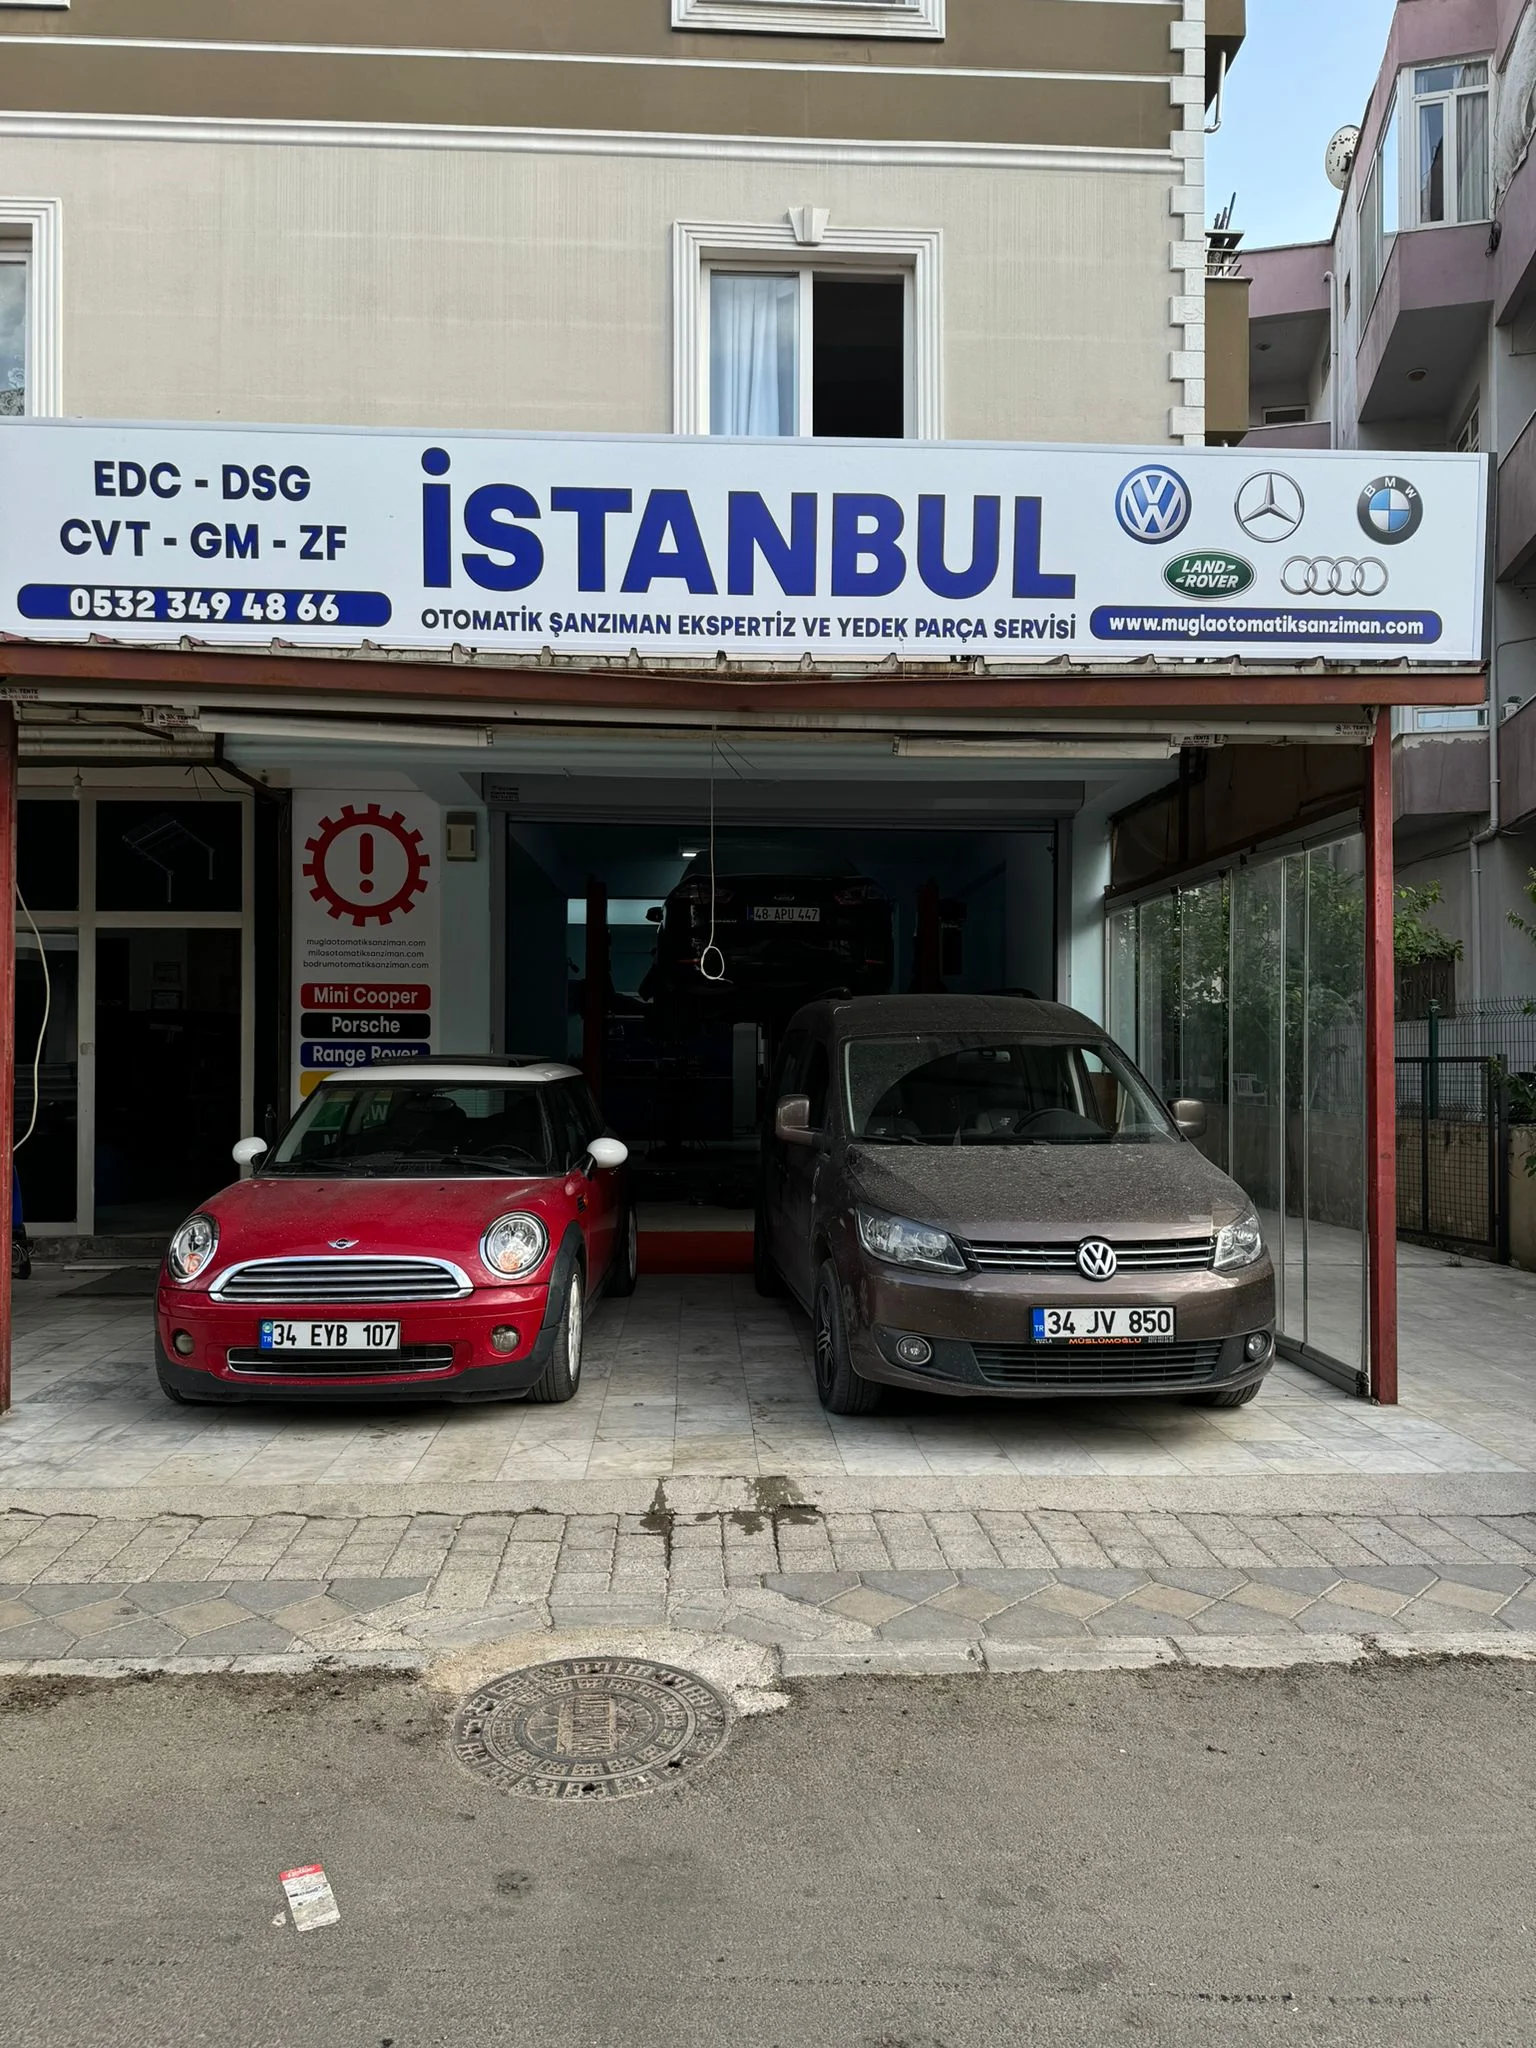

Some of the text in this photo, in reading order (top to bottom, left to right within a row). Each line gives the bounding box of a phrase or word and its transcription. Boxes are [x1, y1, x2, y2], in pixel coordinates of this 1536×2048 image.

[94, 459, 182, 499] EDC
[221, 463, 311, 502] DSG
[1362, 476, 1418, 500] BMW
[420, 446, 1077, 600] İSTANBUL
[59, 518, 151, 557] CVT
[190, 521, 260, 560] GM
[299, 524, 347, 561] ZF
[1181, 559, 1227, 574] LAND
[1184, 574, 1239, 588] ROVER
[69, 587, 340, 622] 0532 349 48 66
[420, 604, 1077, 643] OTOMATİK ŞANZIMAN EKSPERTİZ VE YEDEK PARÇA SERVİSİ
[1109, 612, 1424, 637] www.muglaotomatiksanziman.com
[755, 908, 818, 921] 48 APU 447
[306, 938, 427, 948] muglaotomatiksanziman.com
[303, 960, 430, 969] bodrumotomatiksanziman.com
[313, 986, 418, 1009] Mini Cooper
[331, 1016, 401, 1033] Porsche
[312, 1045, 366, 1067] Range
[1047, 1310, 1171, 1335] 34 JV 850
[263, 1335, 272, 1343] TR
[273, 1324, 397, 1347] 34 EYB 107
